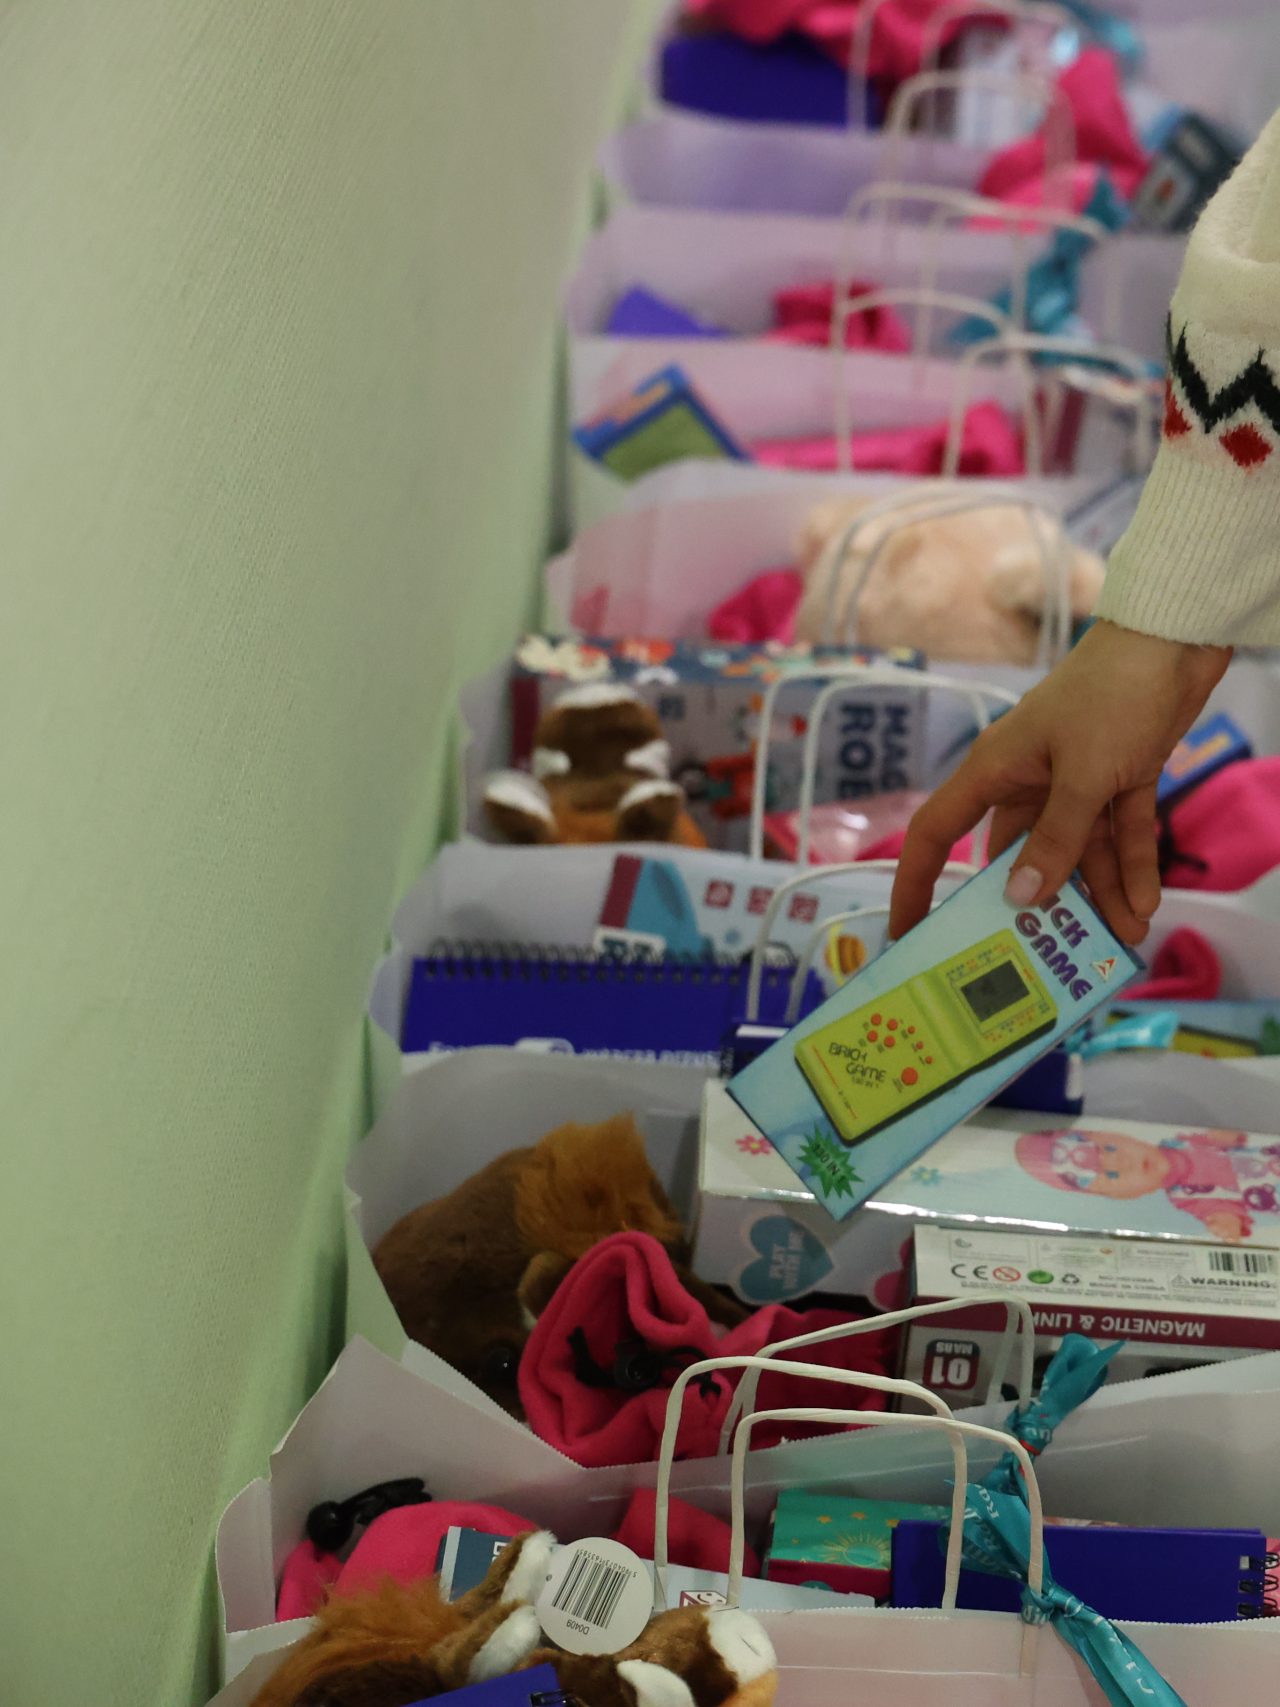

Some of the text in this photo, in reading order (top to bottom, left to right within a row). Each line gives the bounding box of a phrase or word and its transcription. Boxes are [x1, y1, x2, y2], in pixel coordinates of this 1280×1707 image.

[1015, 911, 1093, 1002] GAME
[1079, 1315, 1096, 1331] &
[1100, 1319, 1206, 1338] MAGNETIC
[930, 1356, 972, 1386] 01
[566, 1619, 590, 1635] D0409
